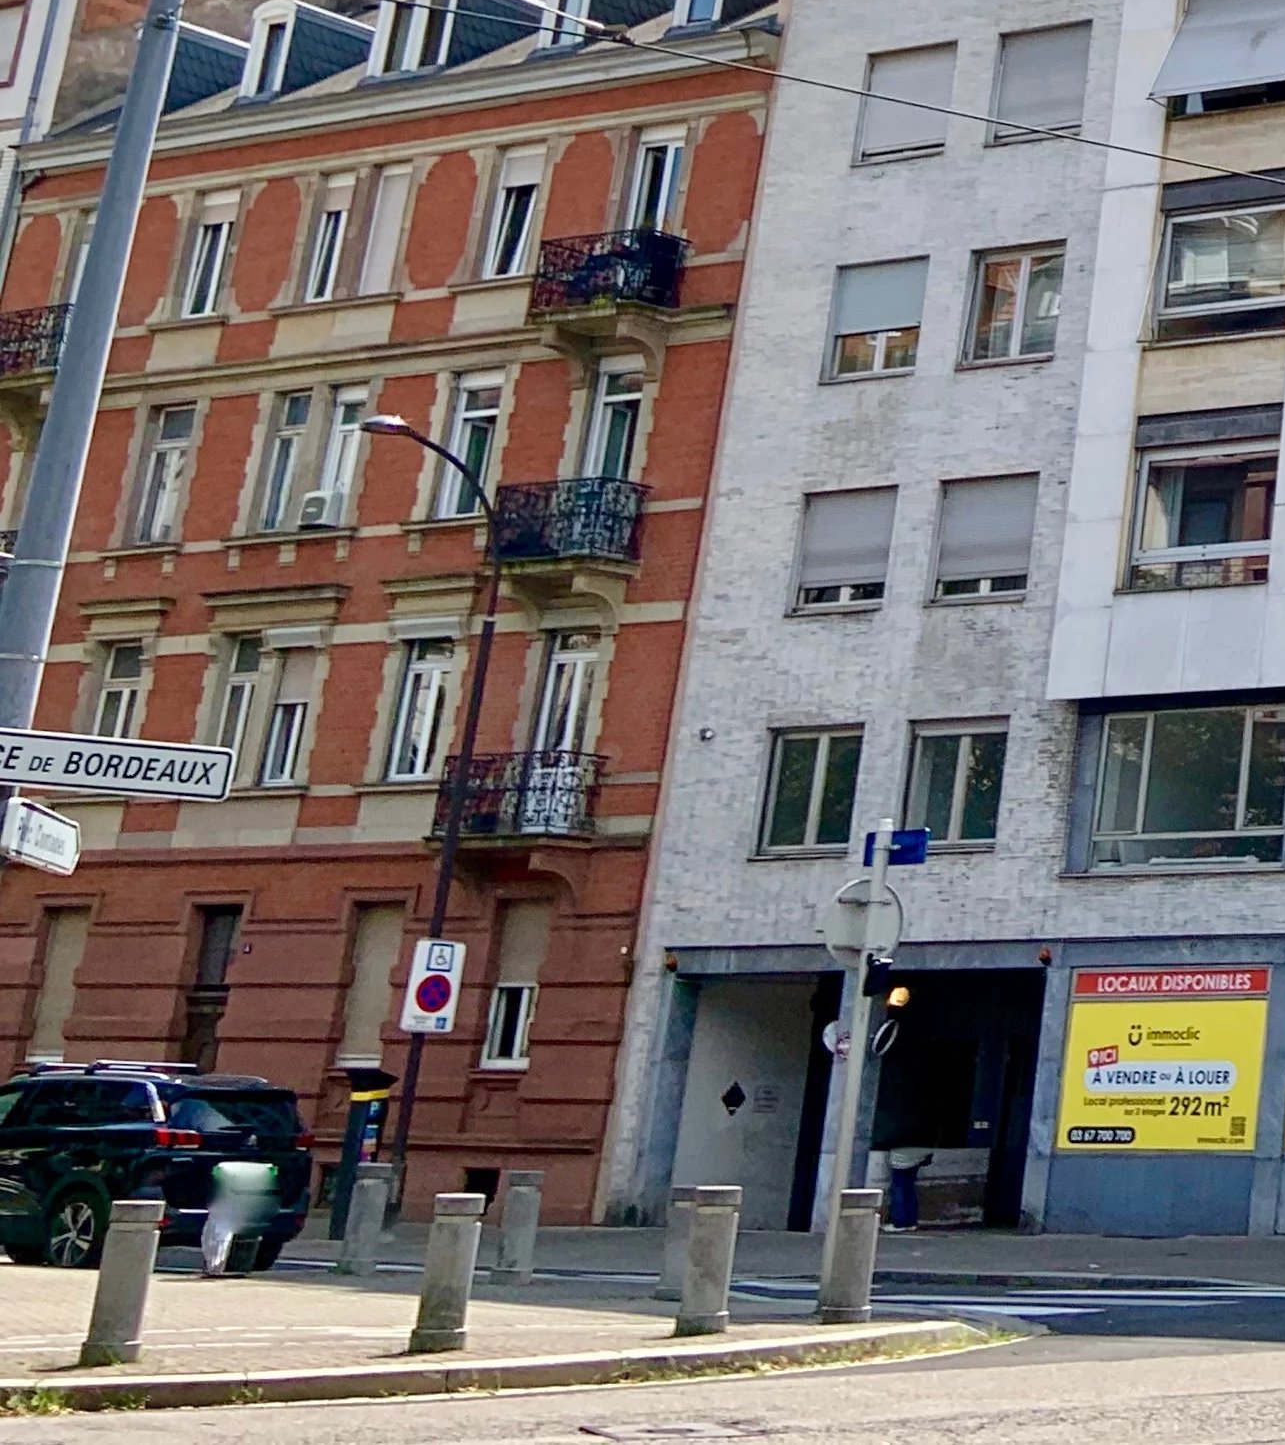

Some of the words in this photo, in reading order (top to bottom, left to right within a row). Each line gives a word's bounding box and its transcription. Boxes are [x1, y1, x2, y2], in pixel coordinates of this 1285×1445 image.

[28, 755, 55, 772] DE
[63, 751, 218, 786] BORDEAUX
[1096, 975, 1159, 993] LOCAUX
[1161, 973, 1252, 992] DISPONIBLES
[1146, 1026, 1200, 1042] immoclic
[1106, 1070, 1156, 1085] VENDRE
[1174, 1066, 1185, 1085] À
[1189, 1070, 1231, 1085] LOUER
[1168, 1096, 1202, 1117] 292
